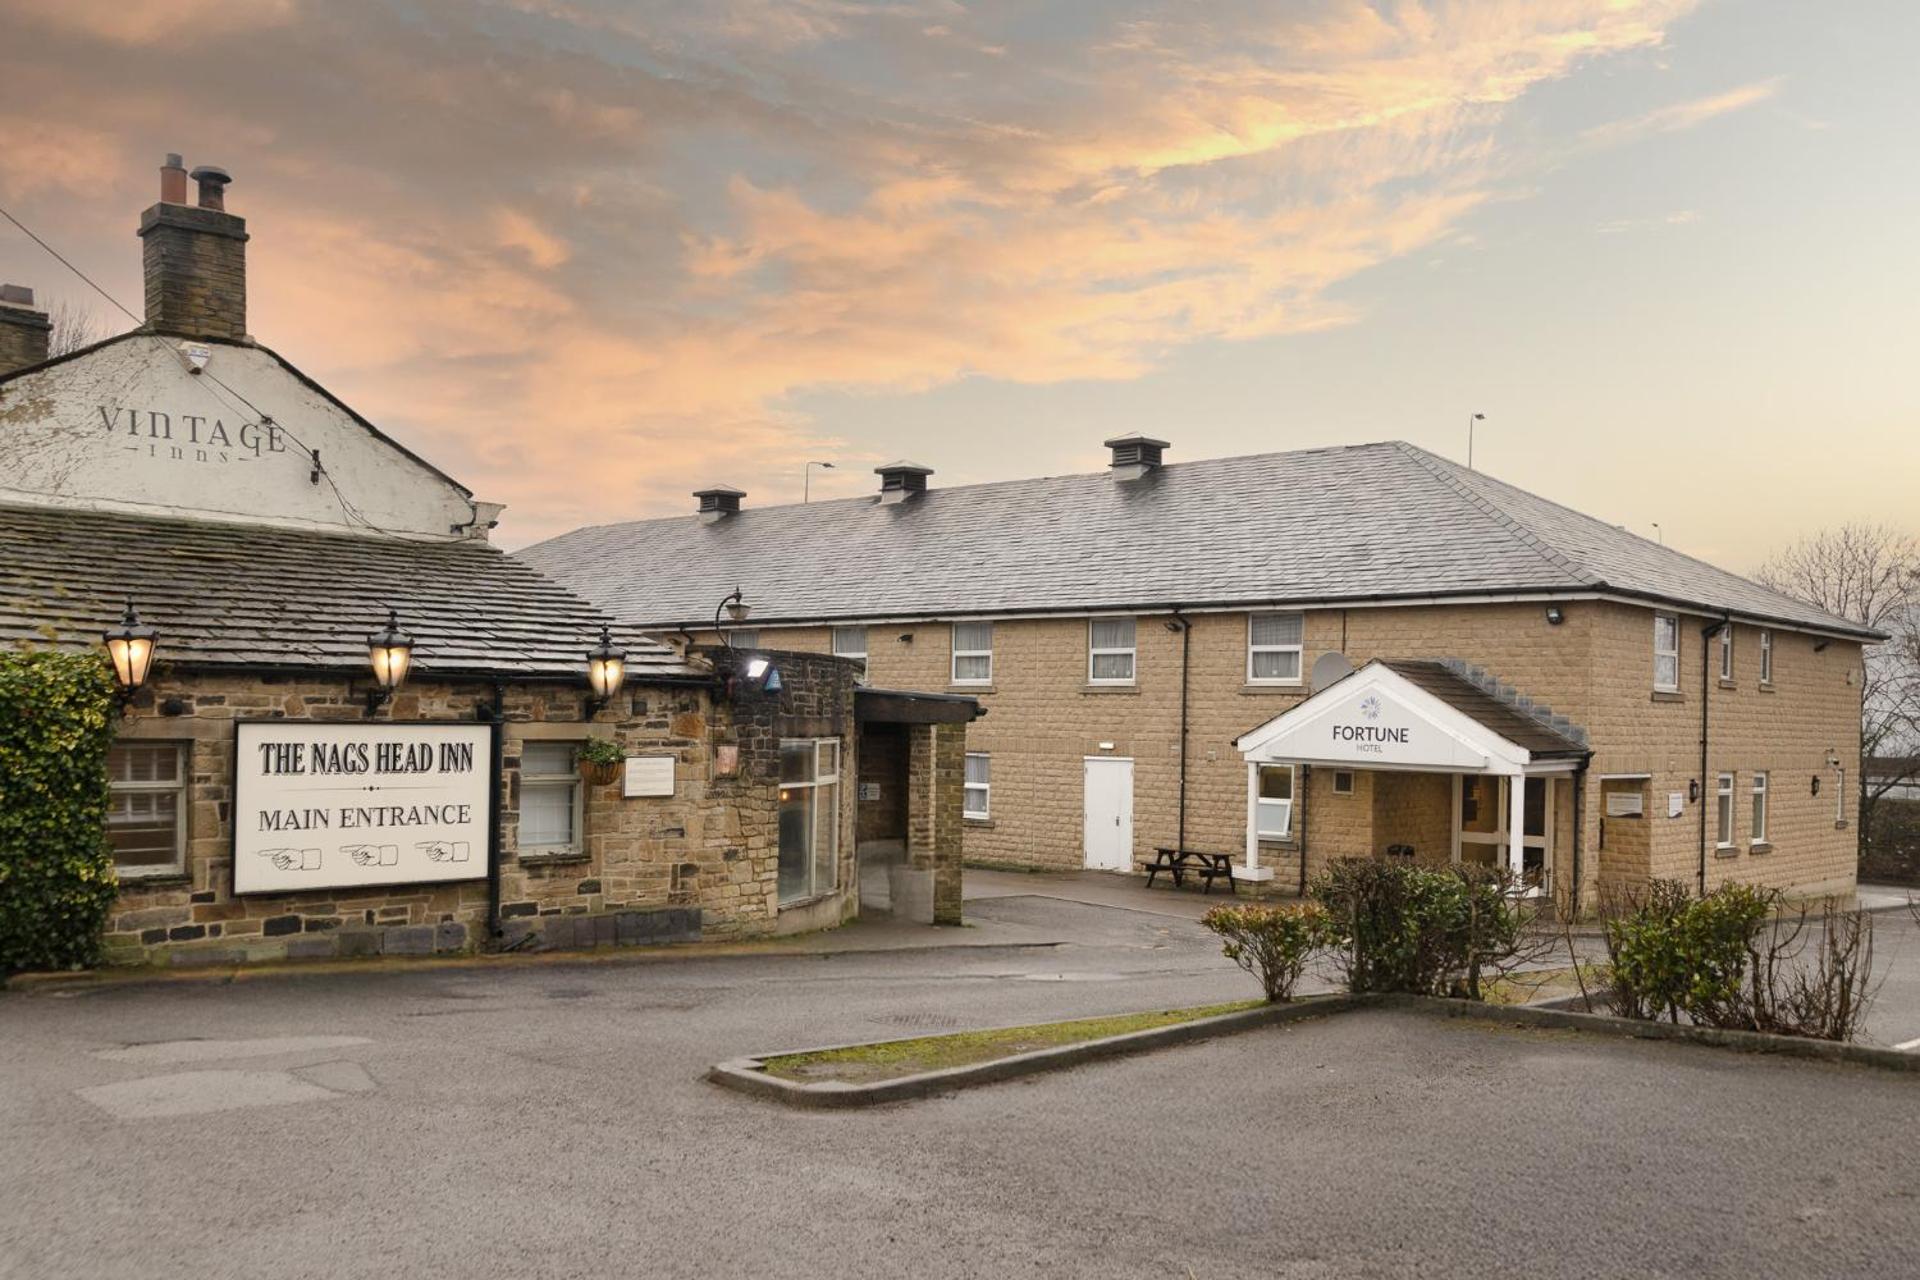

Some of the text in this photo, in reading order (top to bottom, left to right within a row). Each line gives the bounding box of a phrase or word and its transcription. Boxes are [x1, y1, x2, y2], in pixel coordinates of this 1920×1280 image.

[1332, 725, 1410, 743] FORTUNE
[258, 742, 474, 776] THE NAGS HEAD INN
[1355, 744, 1383, 753] HOTEL
[258, 804, 472, 832] MAIN ENTRANCE
